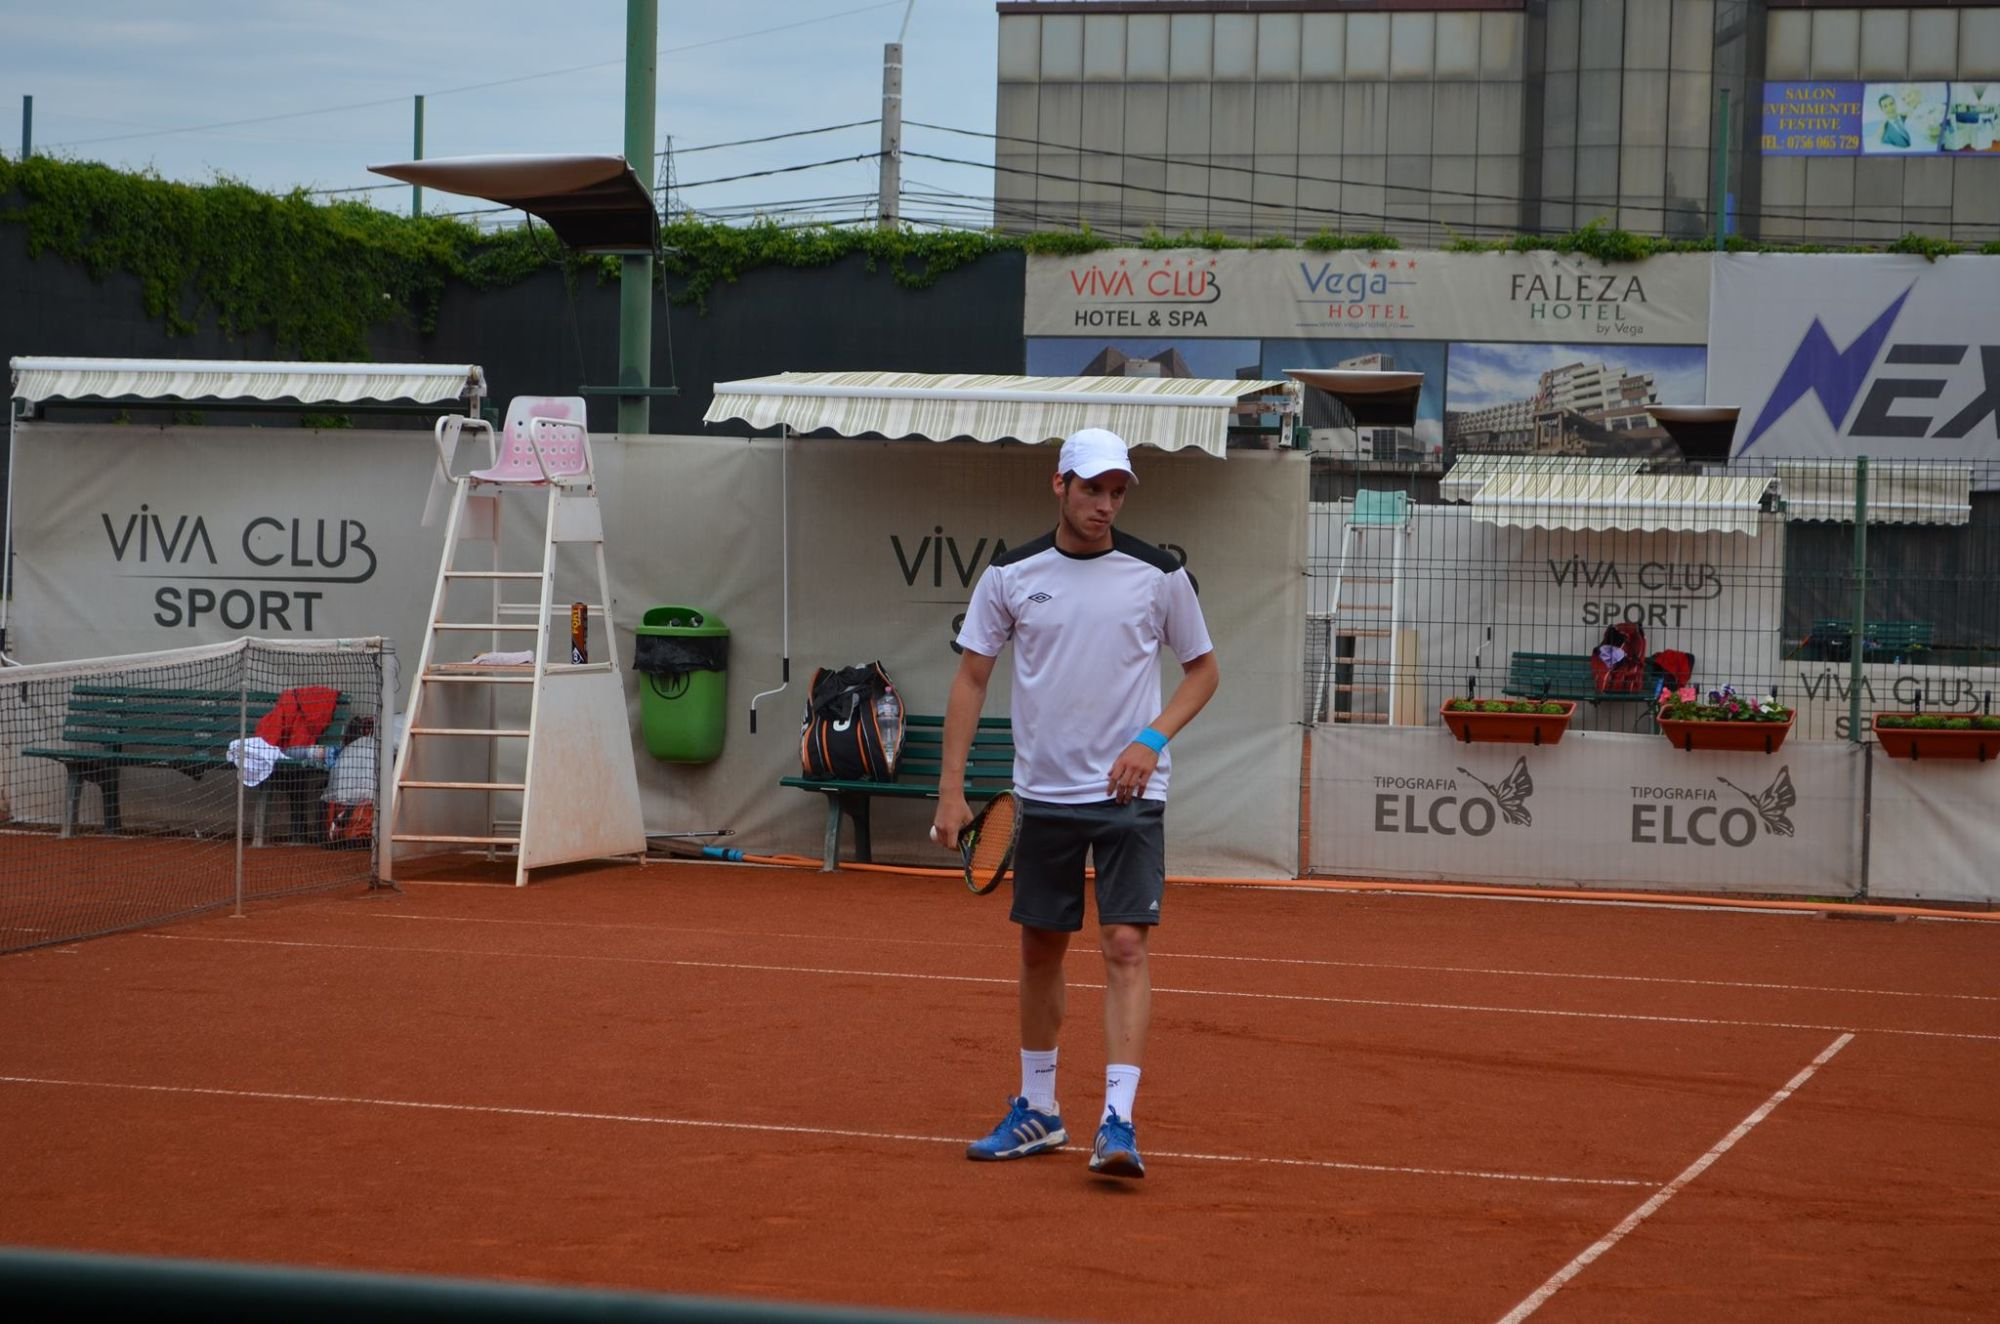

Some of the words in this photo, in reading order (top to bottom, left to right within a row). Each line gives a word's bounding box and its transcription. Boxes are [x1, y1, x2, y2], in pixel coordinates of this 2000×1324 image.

[1148, 270, 1221, 304] CLUB
[1300, 262, 1388, 303] Vega
[1510, 274, 1648, 302] FALEZA
[1075, 310, 1141, 327] HOTEL
[1148, 310, 1161, 327] &
[1168, 310, 1208, 327] SPA
[1329, 303, 1408, 319] HOTEL
[1530, 303, 1626, 321] HOTEL
[1597, 323, 1610, 335] by
[1615, 323, 1644, 336] Vega
[242, 516, 377, 584] CLUB
[1638, 561, 1722, 600] CLUB
[154, 587, 323, 631] SPORT
[1582, 602, 1688, 627] SPORT
[1374, 776, 1457, 790] TIPOGRAFIA
[1631, 786, 1717, 801] TIPOGRAFIA
[1375, 794, 1496, 837] ELCO
[1632, 804, 1757, 847] ELCO
